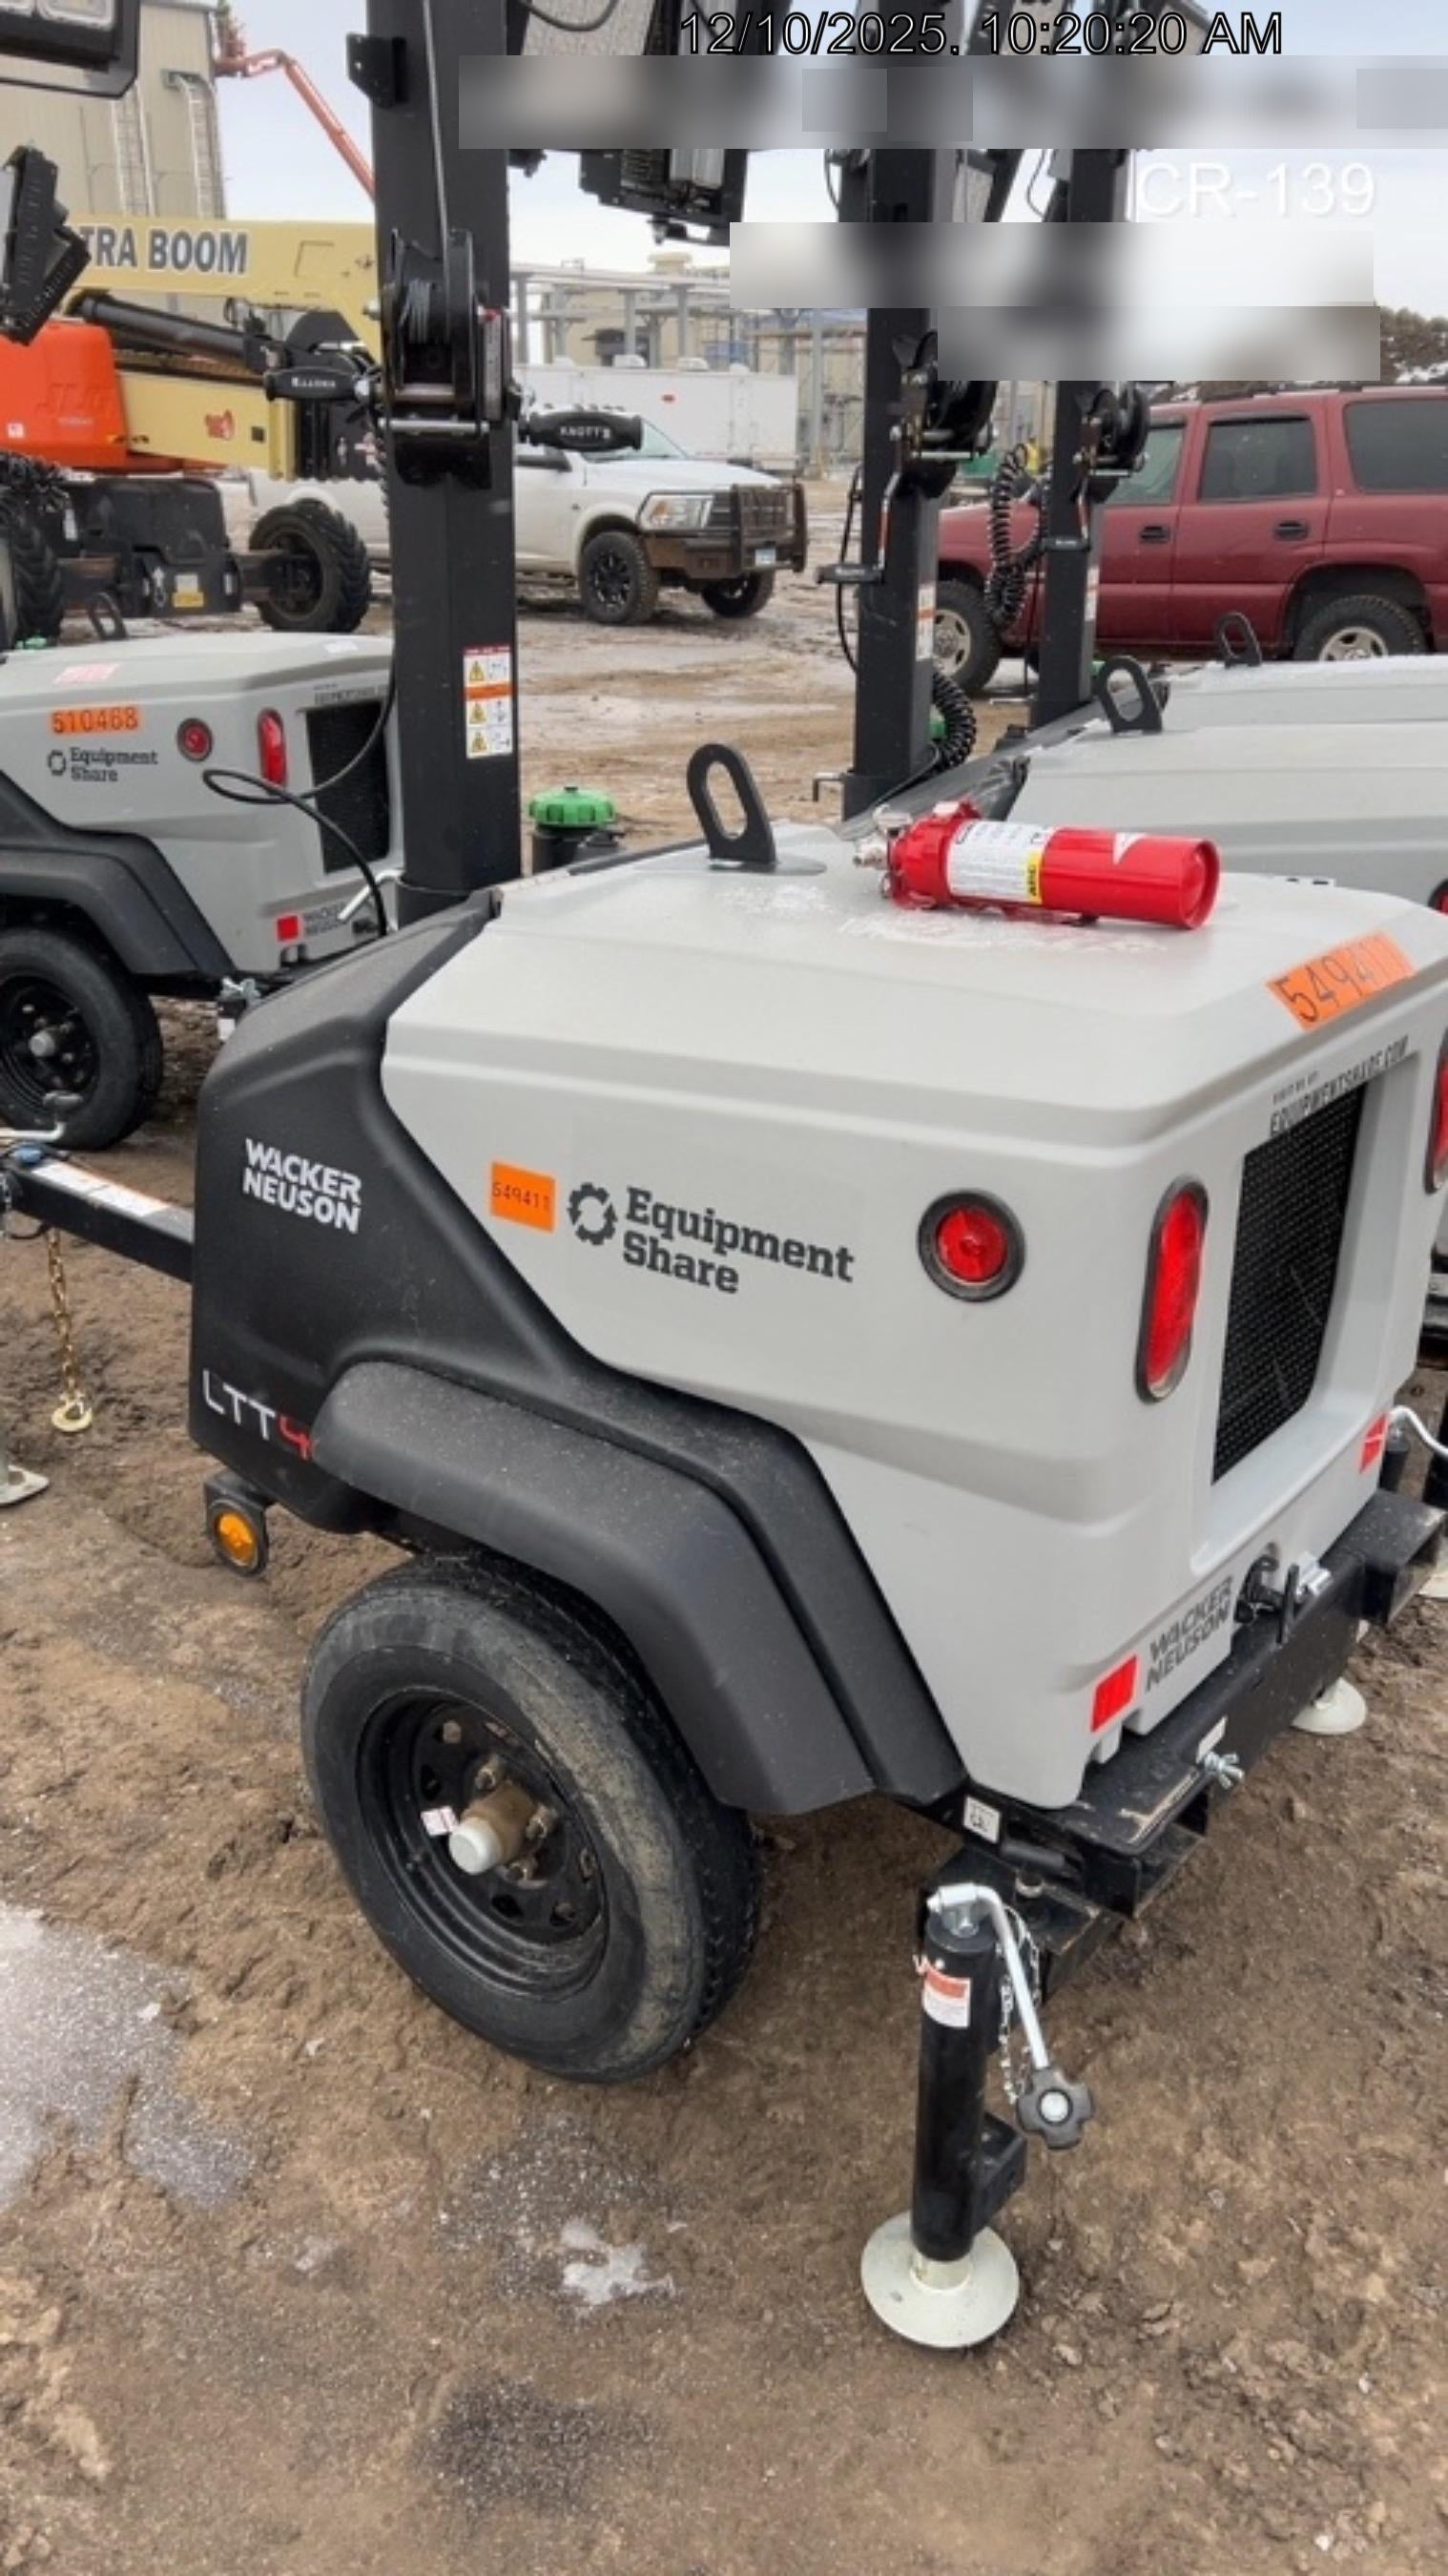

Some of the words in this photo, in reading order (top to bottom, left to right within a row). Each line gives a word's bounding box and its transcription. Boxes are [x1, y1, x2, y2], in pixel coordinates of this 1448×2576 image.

[148, 228, 249, 276] BOOM
[52, 706, 138, 734] 510468
[69, 746, 158, 767] Equipment
[71, 764, 118, 782] Share
[242, 1166, 362, 1235] NEUSON
[245, 1137, 362, 1206] WACKER
[622, 1230, 739, 1295] Share
[625, 1185, 856, 1283] Equipment
[201, 1368, 313, 1462] LTT4
[1145, 1599, 1231, 1694] NEUSON
[1148, 1574, 1232, 1663] WACKER
